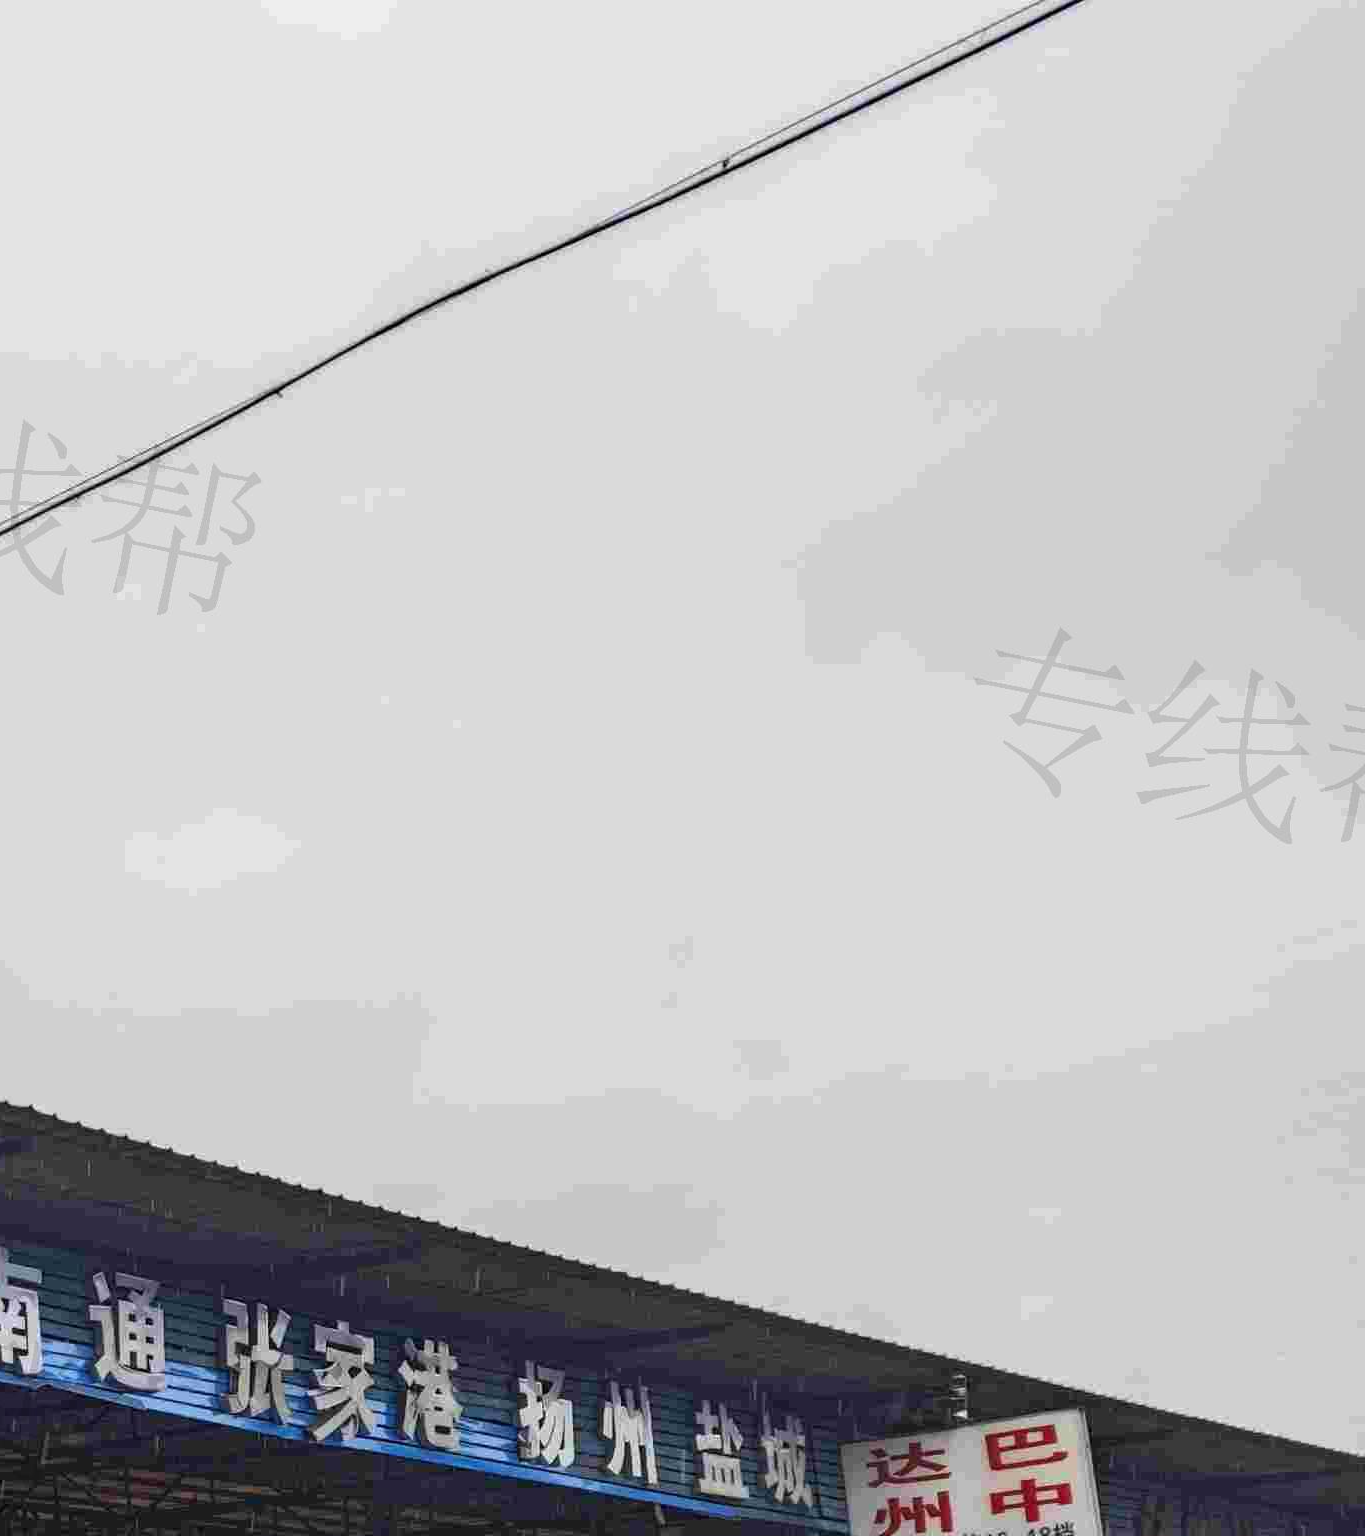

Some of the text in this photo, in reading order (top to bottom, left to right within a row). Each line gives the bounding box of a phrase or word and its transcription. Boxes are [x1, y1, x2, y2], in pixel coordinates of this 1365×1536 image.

[221, 1297, 464, 1450] 张家港
[516, 1360, 659, 1487] 扬州
[694, 1385, 813, 1508] 盐城
[866, 1441, 953, 1536] 达州
[984, 1424, 1073, 1523] 巴中
